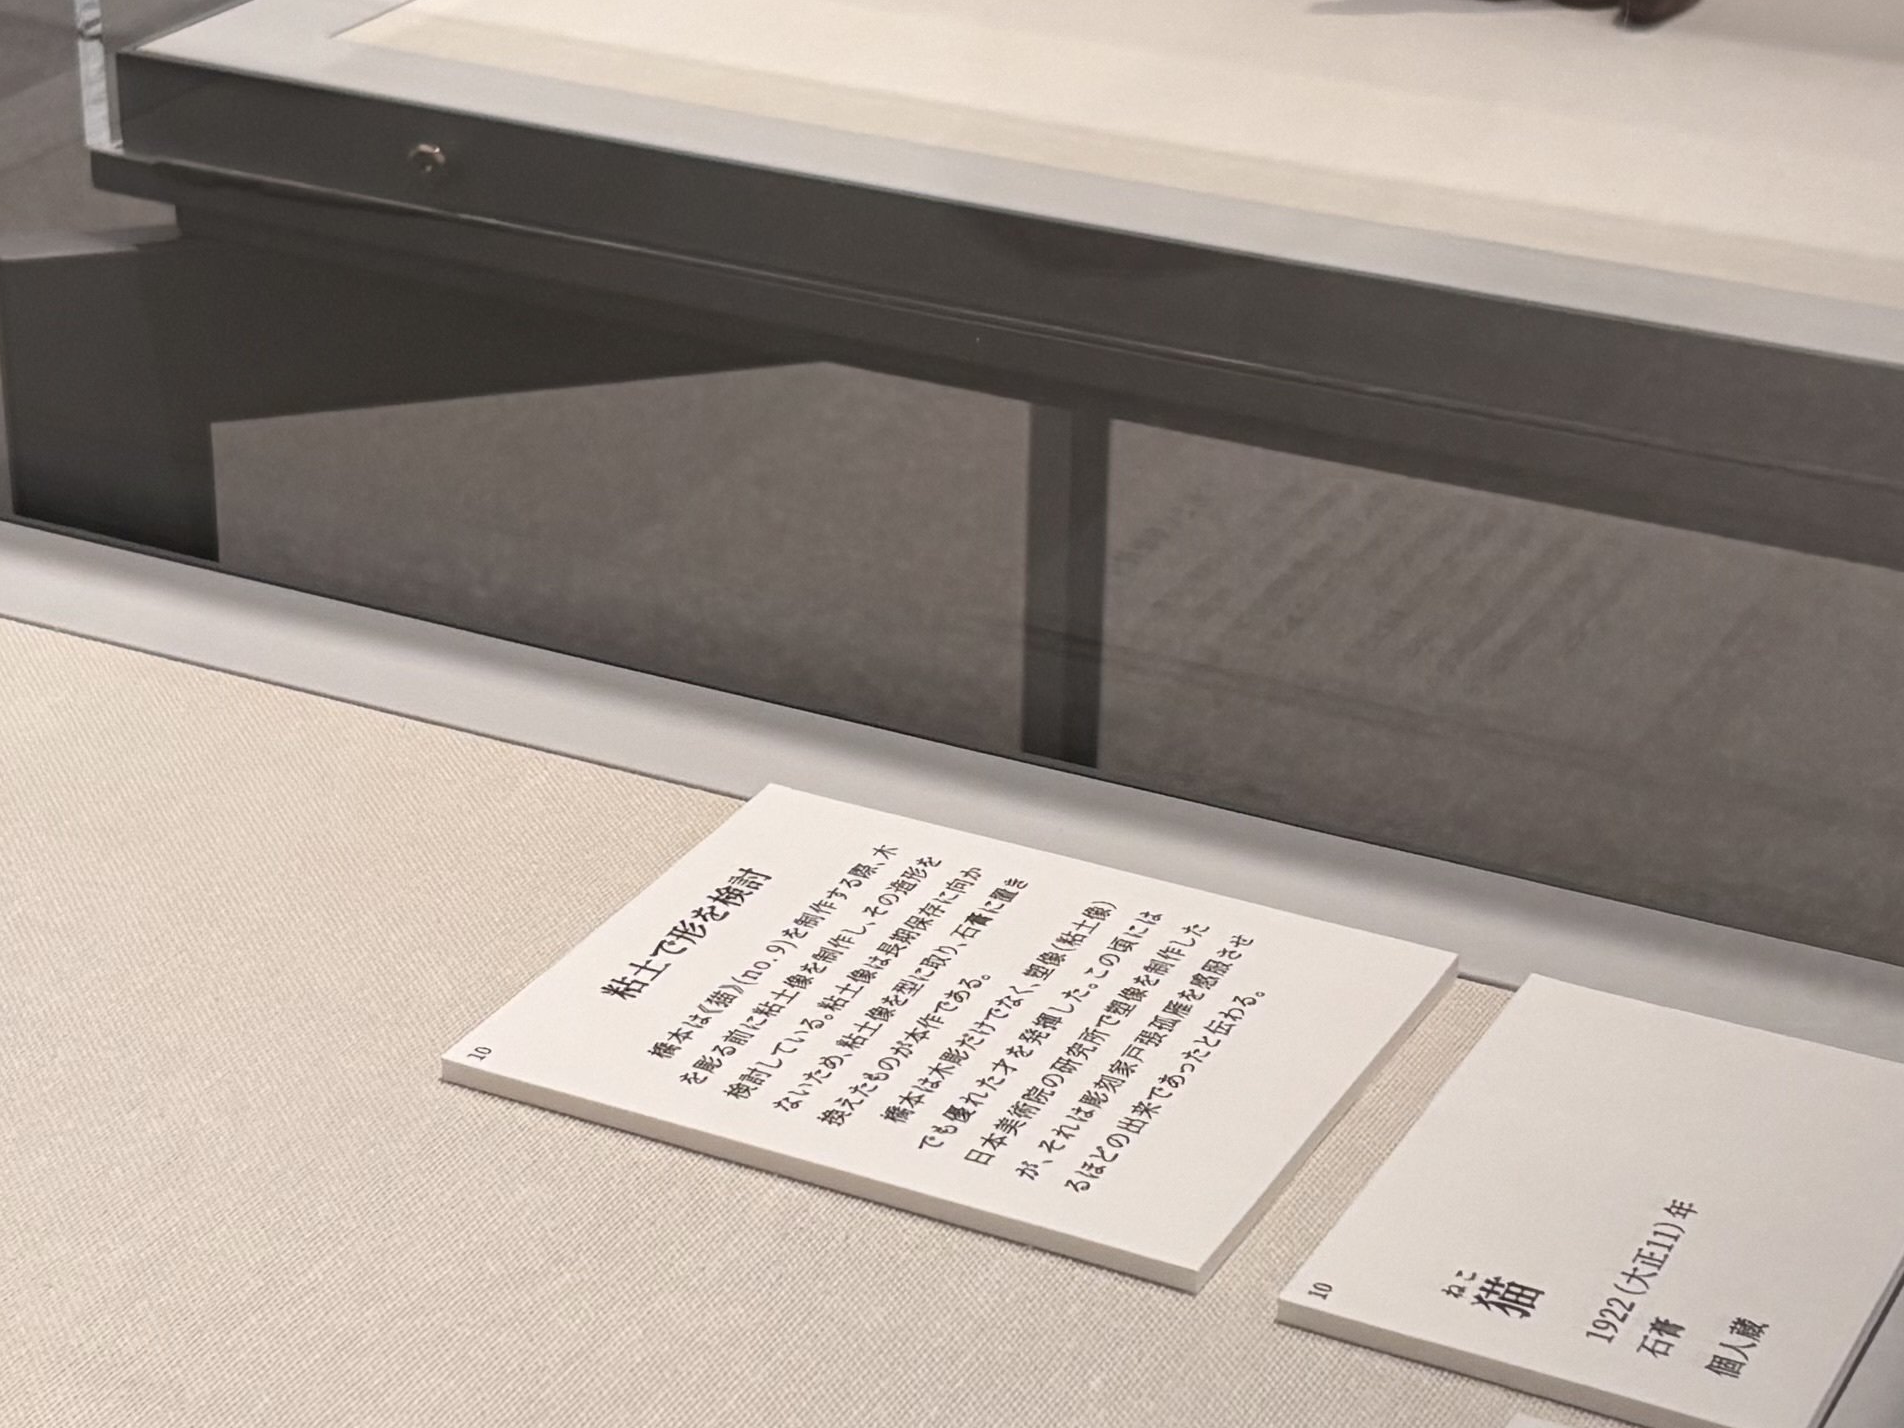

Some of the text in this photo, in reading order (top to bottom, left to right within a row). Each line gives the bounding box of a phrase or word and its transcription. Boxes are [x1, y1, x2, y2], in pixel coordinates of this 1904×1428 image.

[599, 867, 773, 1001] 粘土で形を検討
[679, 856, 943, 1085] を彫る前に粘土像を制作し、その造形を
[722, 866, 982, 1100] 検討している。粘土像は長期保存に向か
[771, 877, 1029, 1113] ないため、粘土像を型に取り、石膏に置き
[466, 1046, 493, 1062] 10
[816, 974, 992, 1128] 換えたものが本作である。
[917, 910, 1164, 1150] でも優れた才を発揮した。この頃には
[963, 923, 1211, 1166] 日本美術院の研究所で塑像を制作した
[1063, 991, 1266, 1194] るほどの出来であったと伝わる。
[1307, 1281, 1334, 1301] 10
[1440, 1269, 1478, 1299] ねこ
[1469, 1275, 1546, 1320] 猫
[1635, 1315, 1687, 1359] 石膏
[1703, 1316, 1770, 1379] 個人蔵
